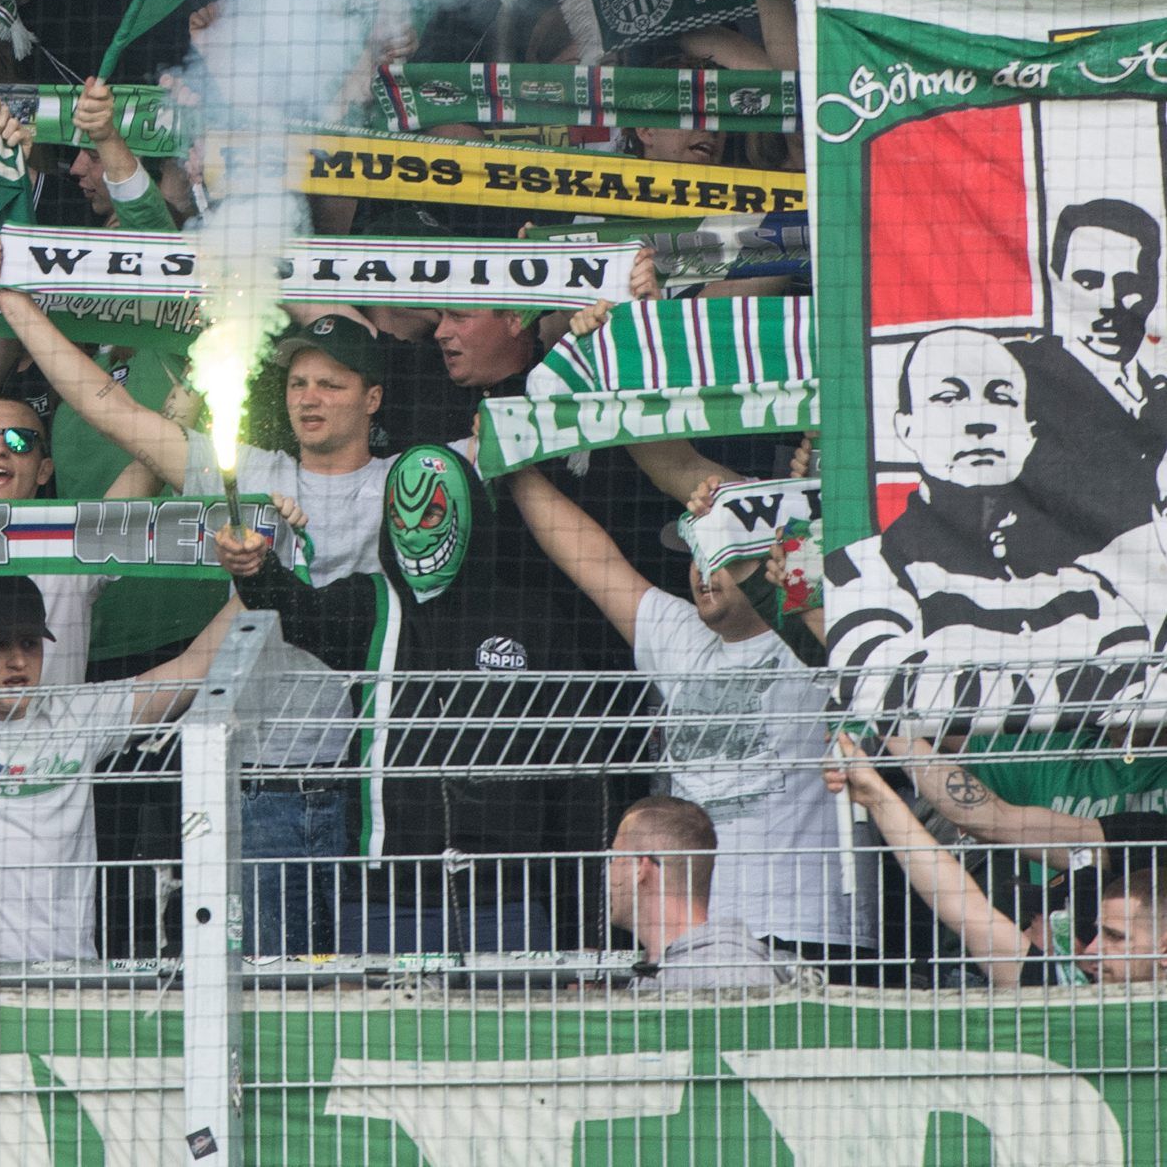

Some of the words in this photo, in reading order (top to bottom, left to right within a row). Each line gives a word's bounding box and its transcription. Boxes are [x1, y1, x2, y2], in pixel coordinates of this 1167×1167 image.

[815, 61, 979, 143] Söhne
[992, 60, 1065, 88] der
[310, 149, 464, 186] MUSS
[485, 386, 710, 466] BLOCK
[479, 649, 525, 667] RAPID
